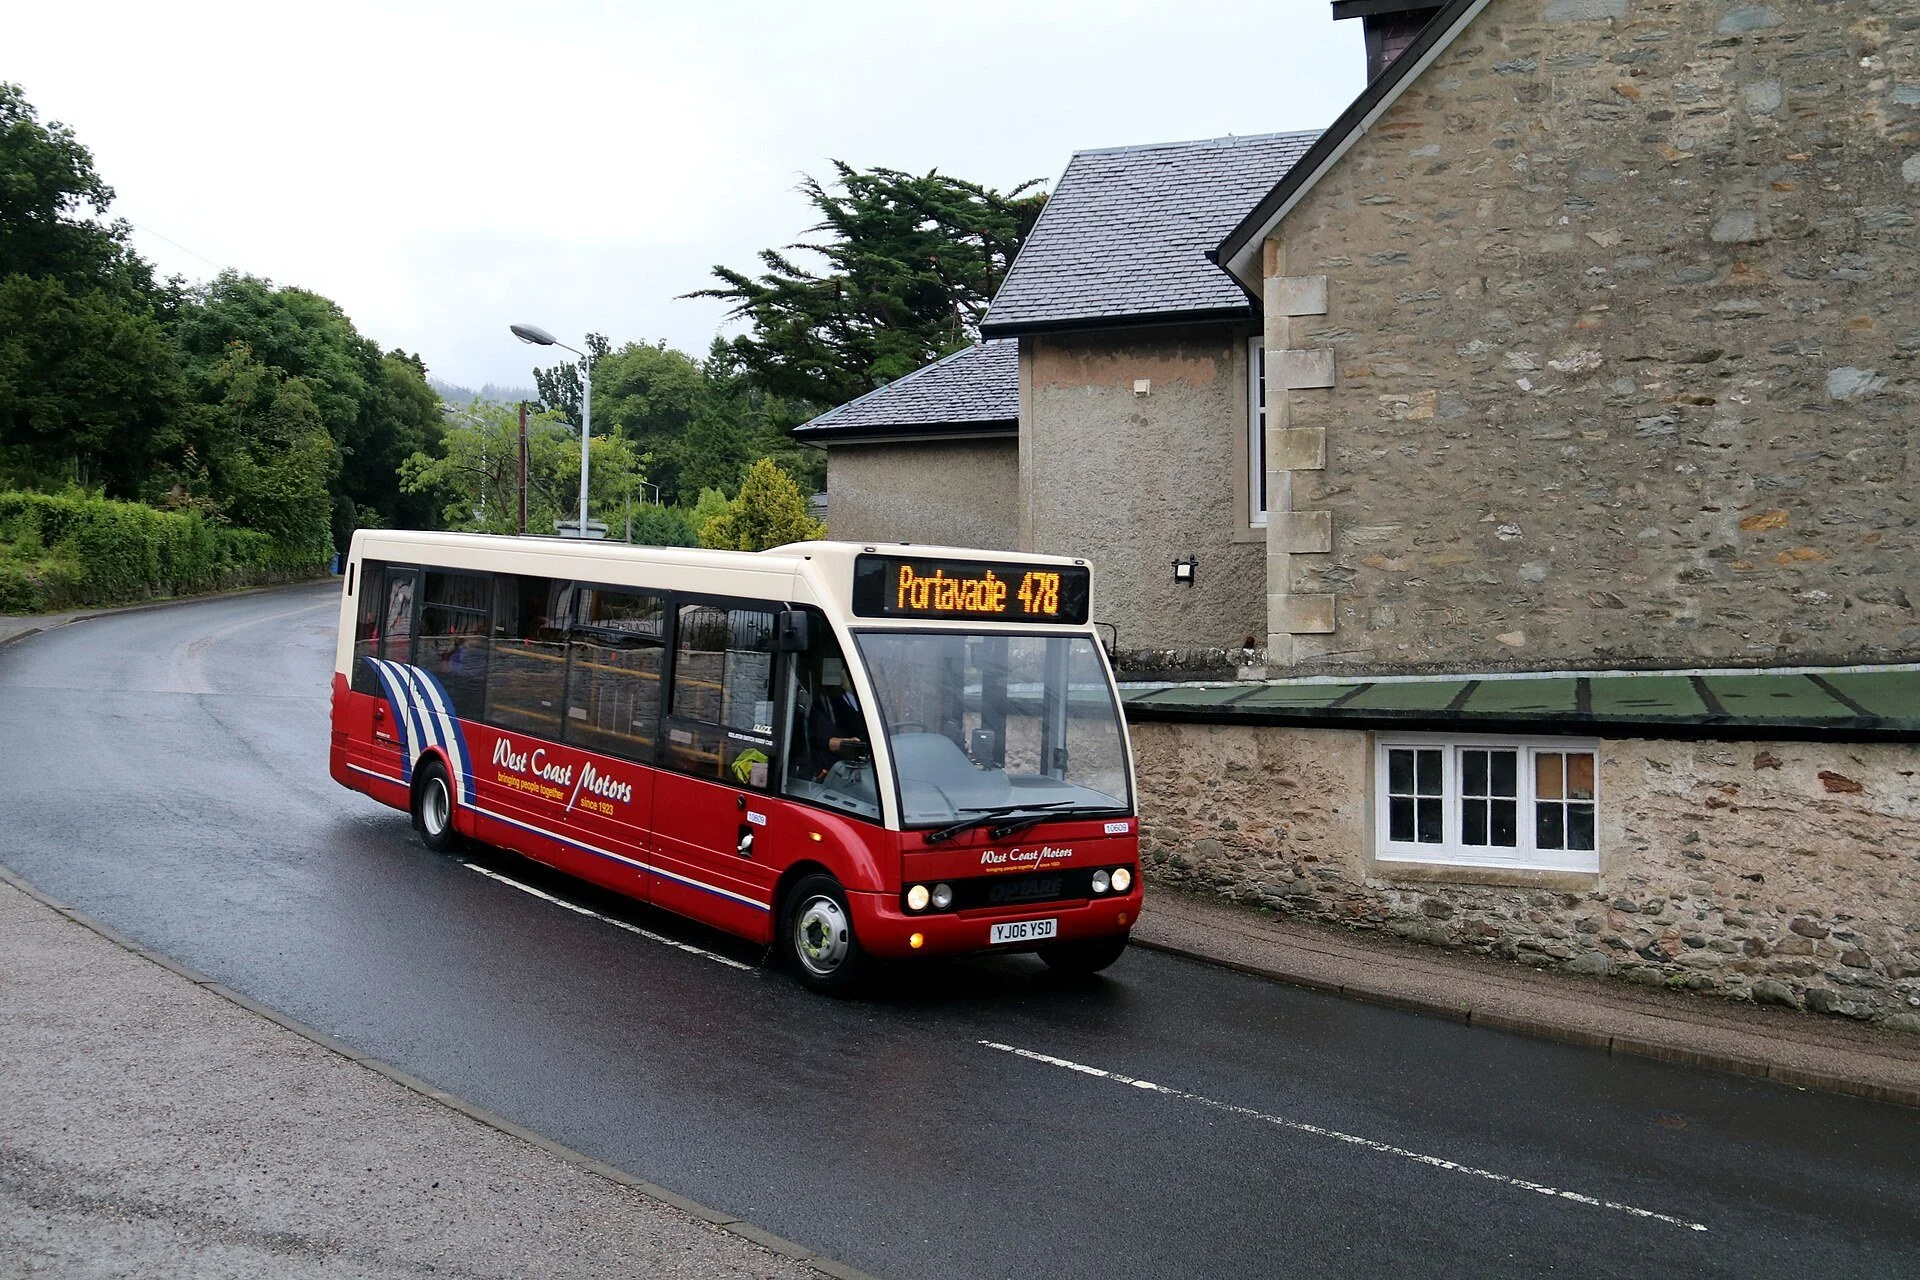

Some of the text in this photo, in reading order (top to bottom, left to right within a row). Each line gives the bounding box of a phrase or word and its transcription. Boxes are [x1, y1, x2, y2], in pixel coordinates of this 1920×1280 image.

[898, 565, 1059, 613] Portavadie 478
[492, 737, 632, 812] West Coast Motors
[498, 771, 564, 800] bringing people together
[580, 796, 614, 815] since 1923
[1106, 824, 1127, 832] 10609
[980, 846, 1072, 870] West Coast Motors
[997, 921, 1050, 940] YJ06 YSD
